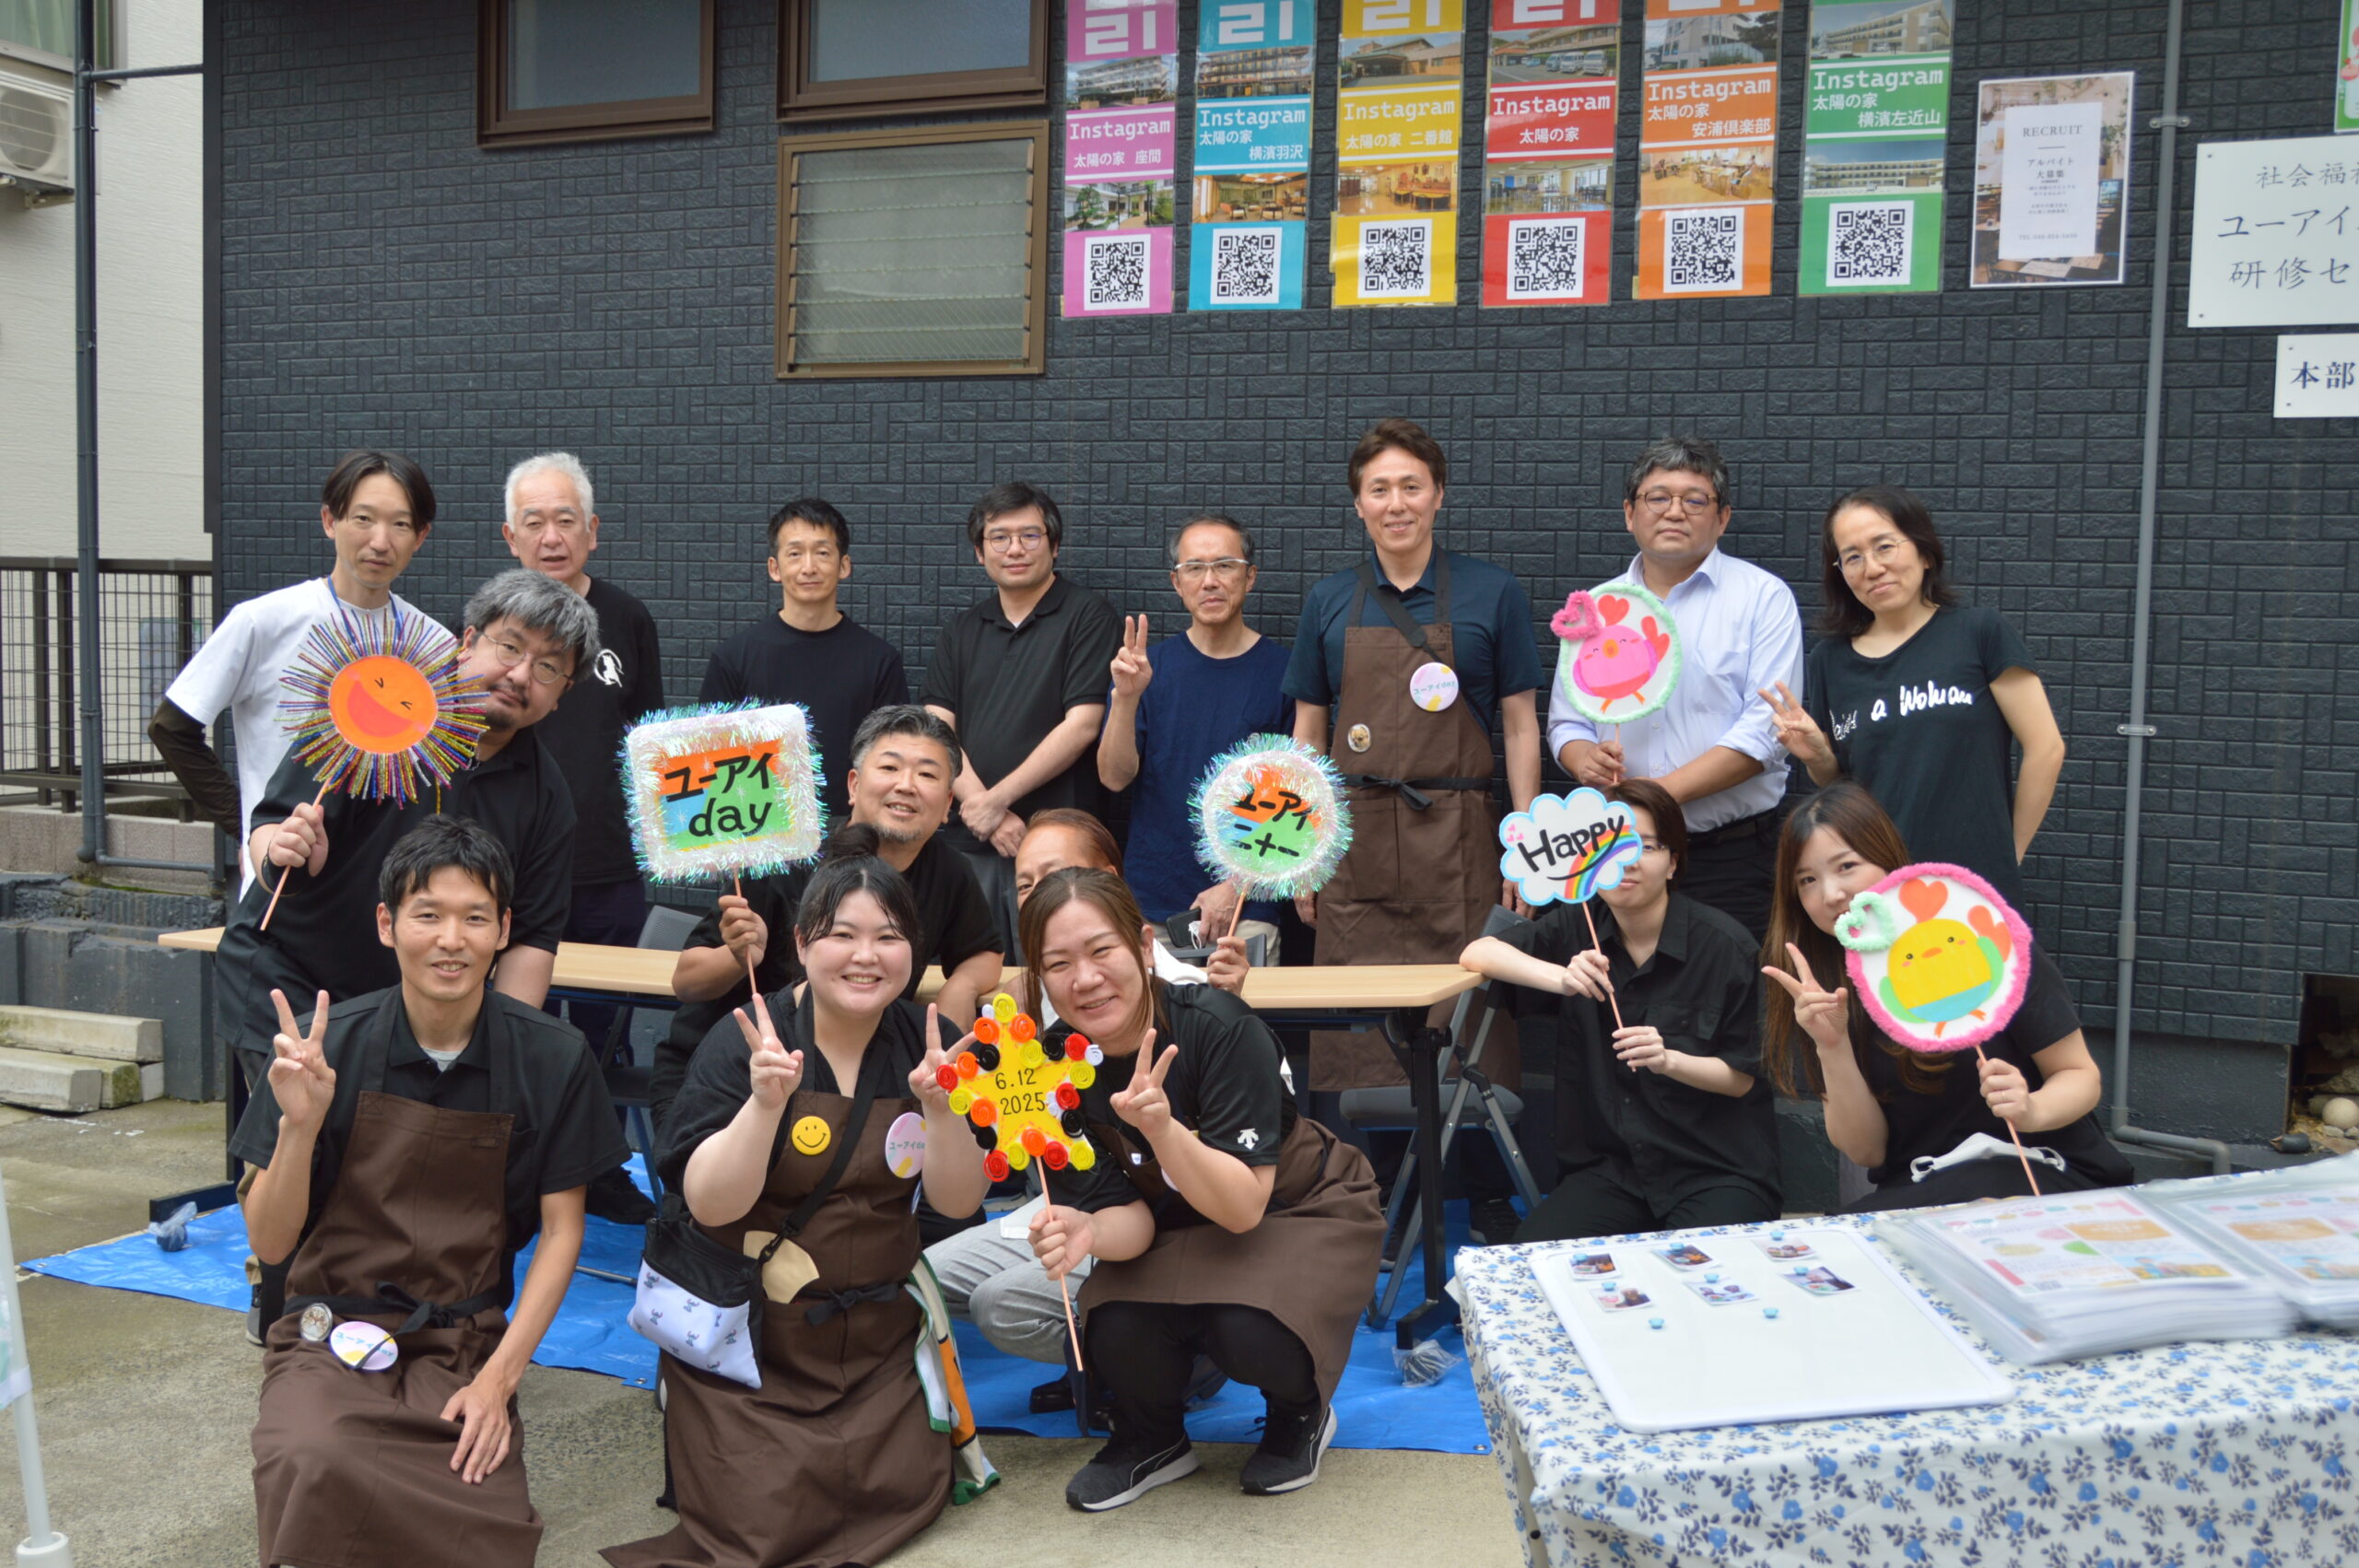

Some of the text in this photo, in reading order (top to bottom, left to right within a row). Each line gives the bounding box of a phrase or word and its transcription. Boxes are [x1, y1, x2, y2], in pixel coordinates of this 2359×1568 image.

[1648, 78, 1771, 102] Instagram
[1813, 70, 1943, 92] Instagram
[1344, 100, 1455, 122] Instagram
[1494, 95, 1611, 117] Instagram
[1648, 102, 1709, 122] 太陽の家
[1813, 92, 1878, 111] 太陽の家
[1200, 109, 1306, 130] Instagram
[1692, 118, 1771, 137] 安浦倶楽部
[1858, 109, 1941, 128] 横濱左近山
[1070, 120, 1170, 140] Instagram
[1200, 130, 1252, 146] 太陽の家
[1345, 129, 1453, 150] 太陽の家 二番館
[1519, 126, 1579, 144] 太陽の家
[2023, 125, 2083, 137] RECRUIT
[1074, 148, 1161, 169] 太陽の家 座間
[1249, 145, 1304, 160] 横濱羽沢
[2217, 205, 2359, 238] ユーアイ
[2228, 257, 2351, 290] 研修セ
[2290, 360, 2356, 390] 本部
[664, 752, 774, 802] ユーアイ
[688, 798, 772, 837] day
[1517, 814, 1625, 881] Happy
[995, 1068, 1037, 1090] 6.12
[1000, 1092, 1045, 1116] 2025
